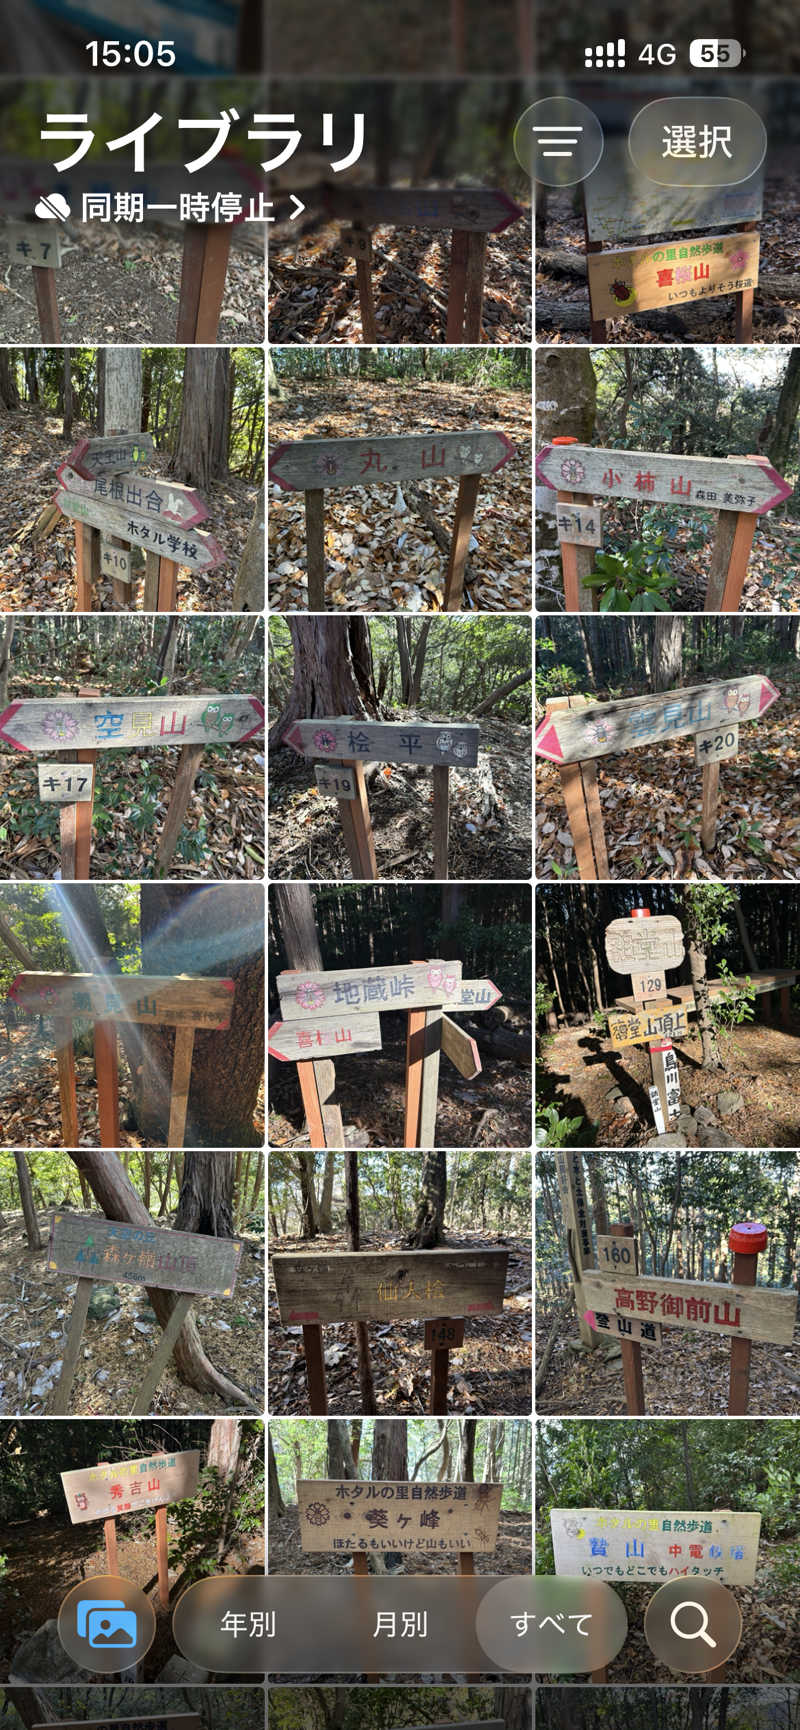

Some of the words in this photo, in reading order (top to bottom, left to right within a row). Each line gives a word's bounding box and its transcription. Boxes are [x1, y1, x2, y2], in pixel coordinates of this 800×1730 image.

[86, 41, 176, 66] 15:05
[638, 43, 676, 66] 4G
[700, 44, 731, 62] 55
[39, 107, 366, 173] ライブラリ
[662, 124, 732, 159] 選択
[81, 191, 275, 223] 同期一時停止
[359, 444, 446, 475] 丸山
[601, 467, 692, 497] 小柿山
[94, 477, 164, 513] 尾根出合
[558, 513, 597, 535] キ14
[127, 520, 199, 560] ホタル学校
[103, 551, 127, 570] キ10
[93, 709, 188, 741] 空見山
[347, 731, 424, 755] 桧平
[699, 732, 736, 755] キ20
[42, 776, 88, 793] キ17
[319, 778, 351, 793] キ19
[332, 974, 416, 1006] 地蔵峠
[640, 978, 662, 992] 129
[602, 1247, 632, 1264] 160
[614, 1288, 742, 1327] 高野御前山
[596, 1312, 657, 1342] 登山道
[109, 1478, 160, 1500] 秀吉山
[336, 1485, 467, 1500] ホタルの里自然歩道
[597, 1517, 713, 1534] ホタルの里自然歩道
[333, 1538, 471, 1550] ほたるもいいけど山もいい
[581, 1565, 725, 1577] いつでもどこでもハイタッチ
[220, 1610, 276, 1638] 年別
[373, 1611, 428, 1638] 月別
[511, 1610, 593, 1637] すべて
